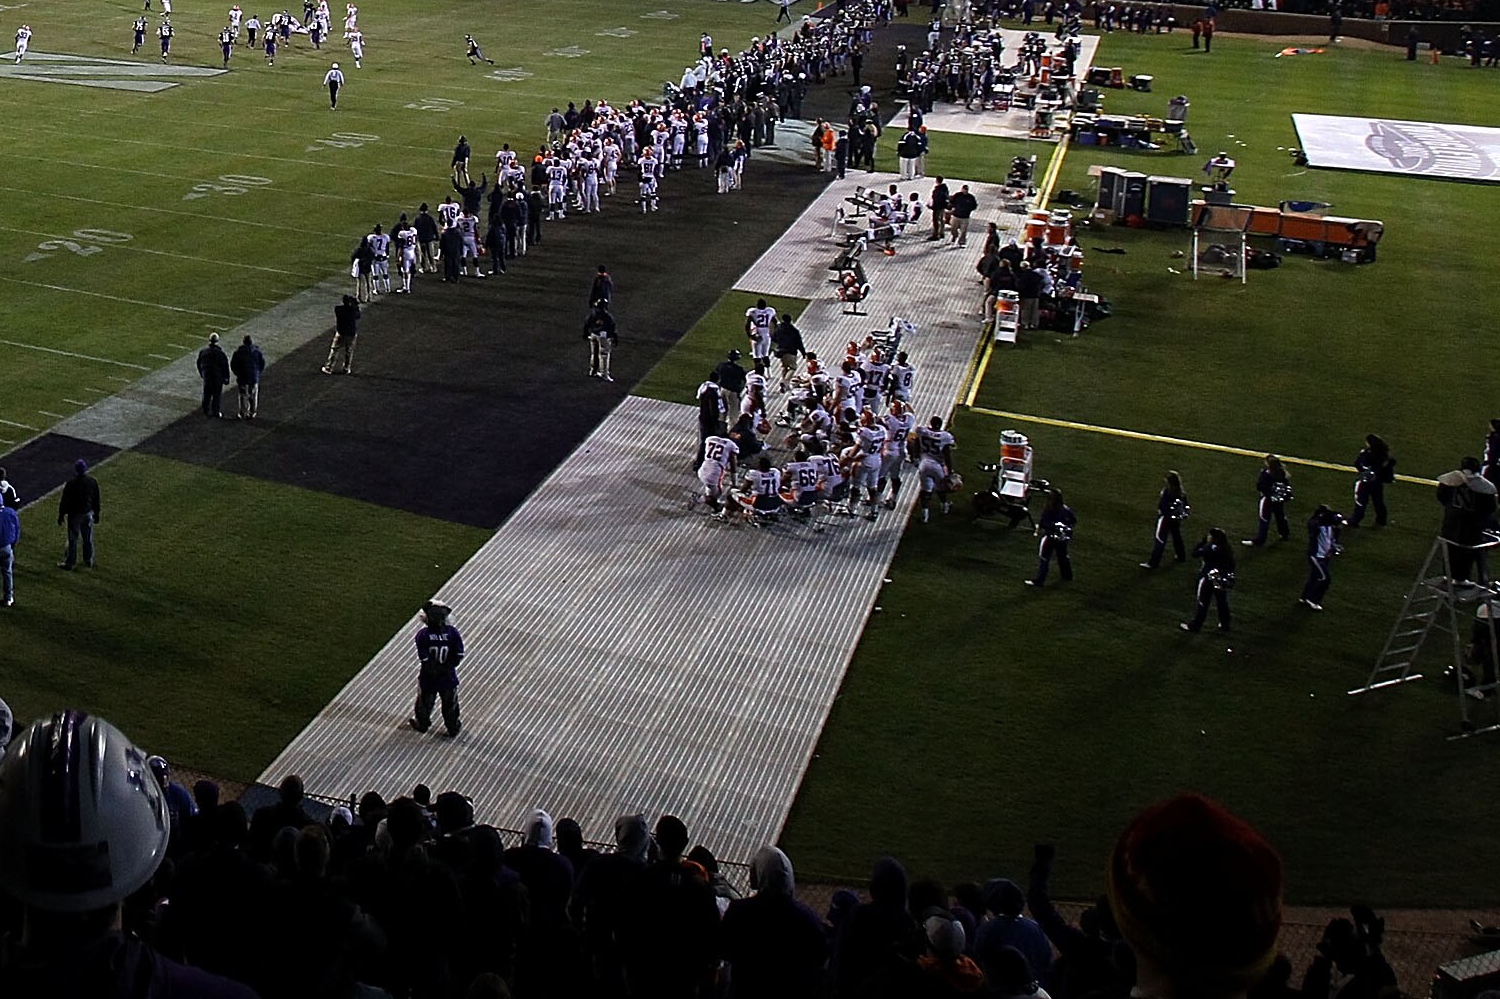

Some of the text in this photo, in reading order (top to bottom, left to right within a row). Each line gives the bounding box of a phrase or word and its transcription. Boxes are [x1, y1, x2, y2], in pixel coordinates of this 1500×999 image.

[552, 170, 562, 181] 13
[193, 174, 273, 196] 30
[445, 207, 456, 219] 16
[38, 228, 134, 256] 20
[377, 238, 382, 251] 7
[757, 314, 769, 328] 21
[869, 370, 883, 386] 17
[903, 372, 912, 387] 8
[707, 442, 724, 461] 72
[921, 435, 940, 455] 55
[823, 458, 841, 476] 76
[800, 469, 815, 487] 66
[761, 479, 777, 497] 71
